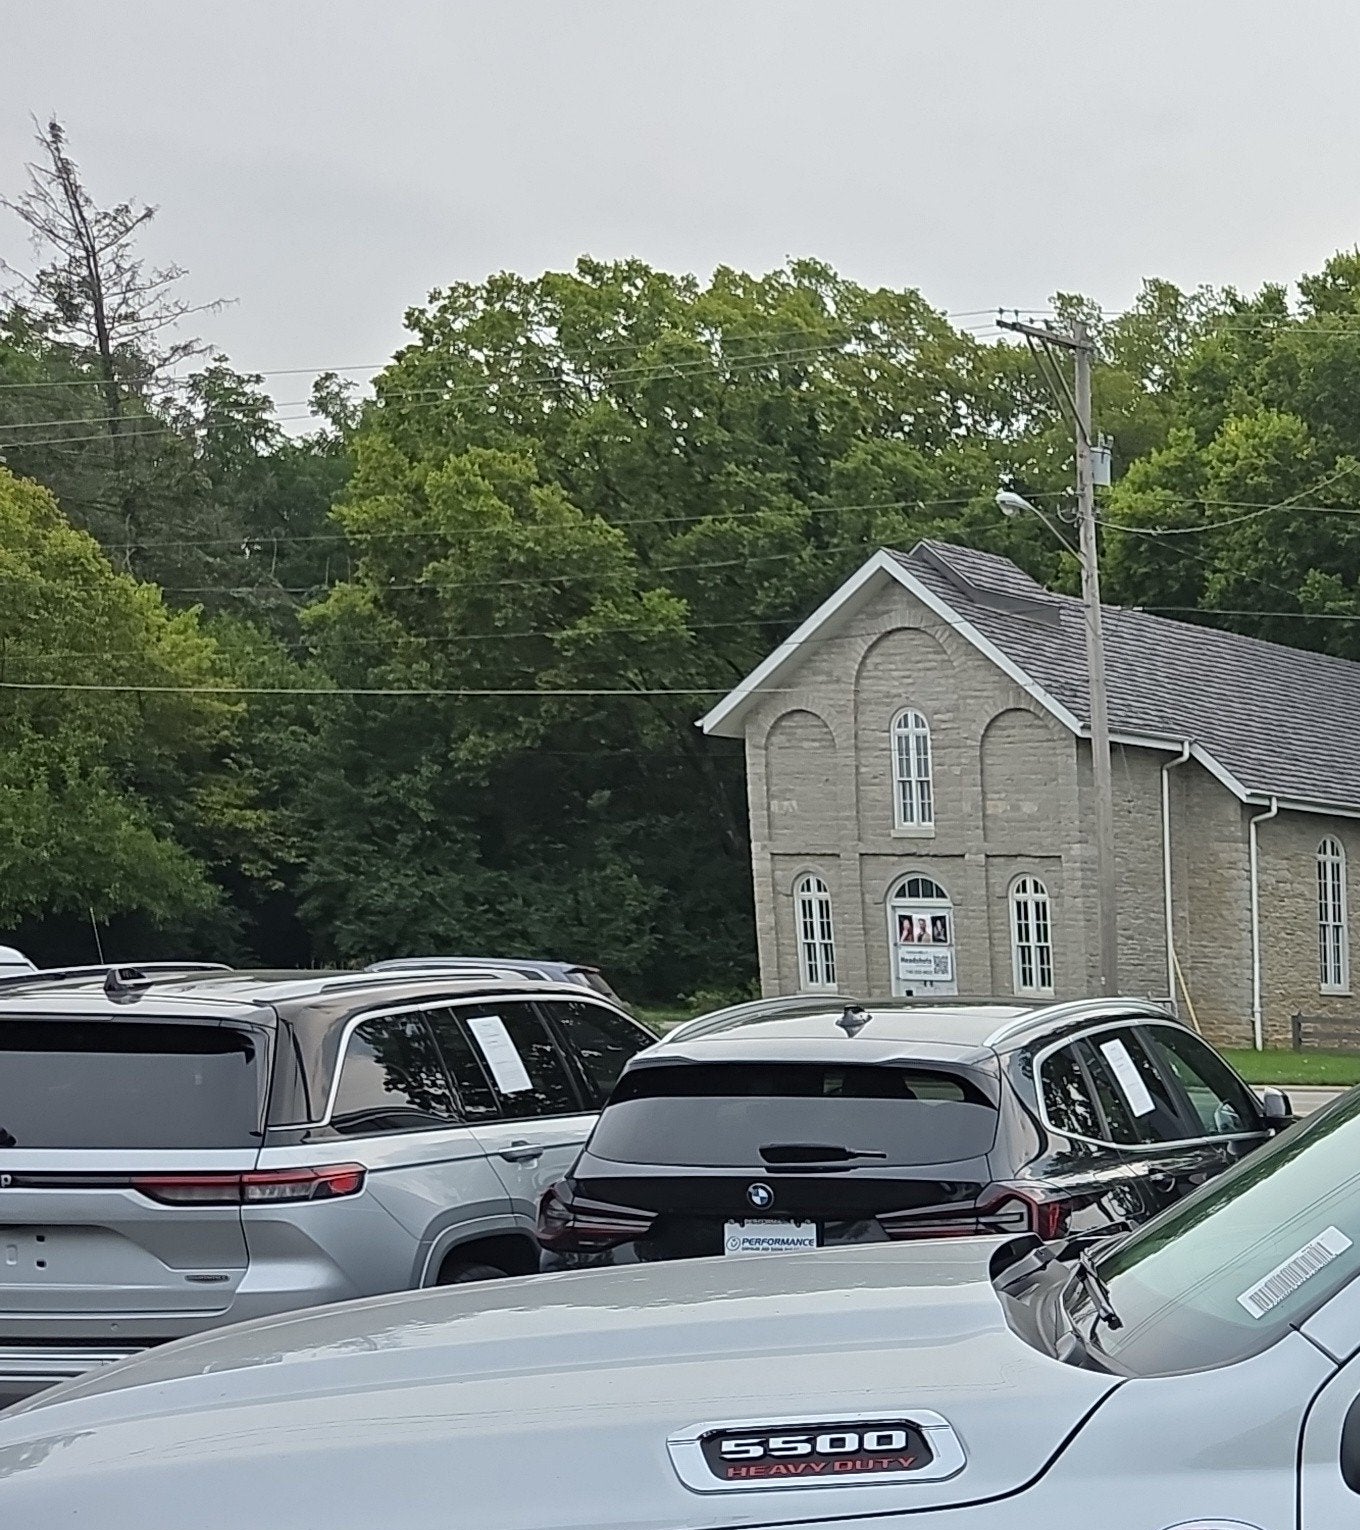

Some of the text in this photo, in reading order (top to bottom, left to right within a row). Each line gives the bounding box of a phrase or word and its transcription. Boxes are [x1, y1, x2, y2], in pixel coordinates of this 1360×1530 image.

[741, 1237, 815, 1247] PERFORMANCE
[719, 1430, 907, 1460] 5500
[727, 1457, 917, 1478] HEAVY DUTY
